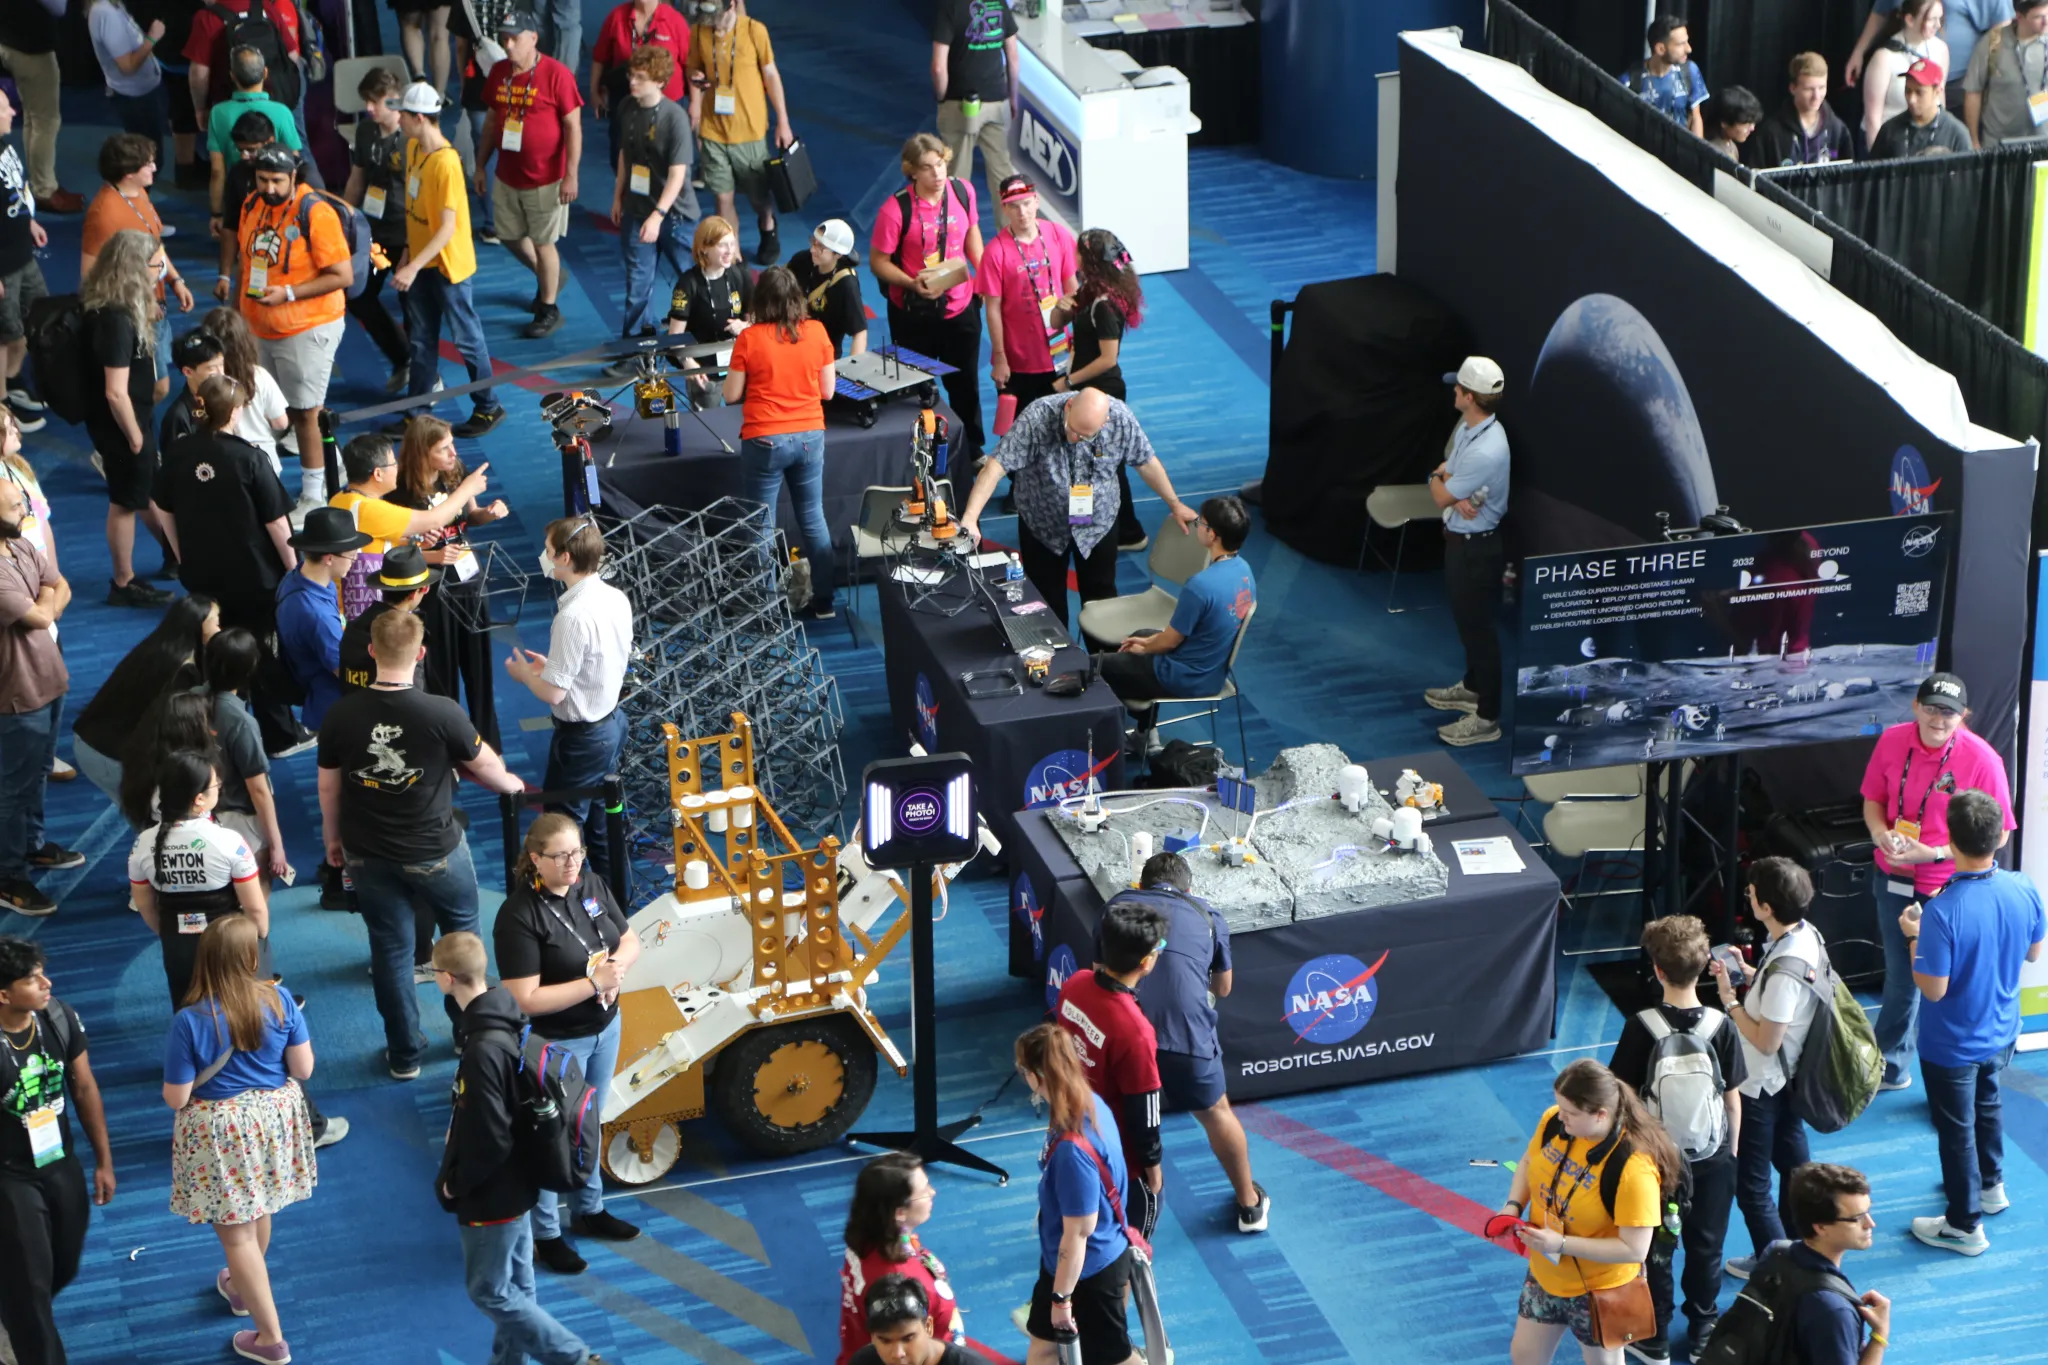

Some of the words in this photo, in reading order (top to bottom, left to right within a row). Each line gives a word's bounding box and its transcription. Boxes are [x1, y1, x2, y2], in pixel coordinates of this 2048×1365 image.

[1893, 471, 1930, 514] NASA
[1810, 546, 1850, 559] BEYOND
[1535, 559, 1616, 584] PHASE
[1627, 550, 1706, 574] THREE
[1543, 591, 1567, 599] ENABLE
[1568, 586, 1619, 597] LONG-DURATION
[1620, 580, 1670, 591] LONG-DISTANCE
[1729, 592, 1775, 604] SUSTAINED
[1776, 589, 1808, 599] HUMAN
[1808, 583, 1852, 596] PRESENCE
[1550, 599, 1593, 609] EXPLORATION
[1602, 594, 1627, 603] DEPLOY
[1550, 608, 1597, 619] DEMONSTRATE
[1597, 604, 1634, 614] UNCREWED
[1658, 599, 1684, 607] RETURN
[1530, 621, 1564, 631] ESTABLISH
[1565, 619, 1592, 628] ROUTINE
[1593, 614, 1625, 624] LOGISTICS
[1626, 611, 1661, 621] DELIVERIES
[1662, 609, 1681, 617] FROM
[1681, 607, 1702, 615] EARTH
[1030, 776, 1103, 803] NASA
[906, 809, 936, 818] PHOTO!
[907, 803, 926, 811] TAKE
[161, 852, 205, 870] EWTON
[165, 870, 207, 885] USTERS
[1291, 984, 1374, 1014] NASA
[1064, 1005, 1101, 1044] VOLUNTEER
[1241, 1032, 1436, 1077] ROBOTICS.NASA.GOV
